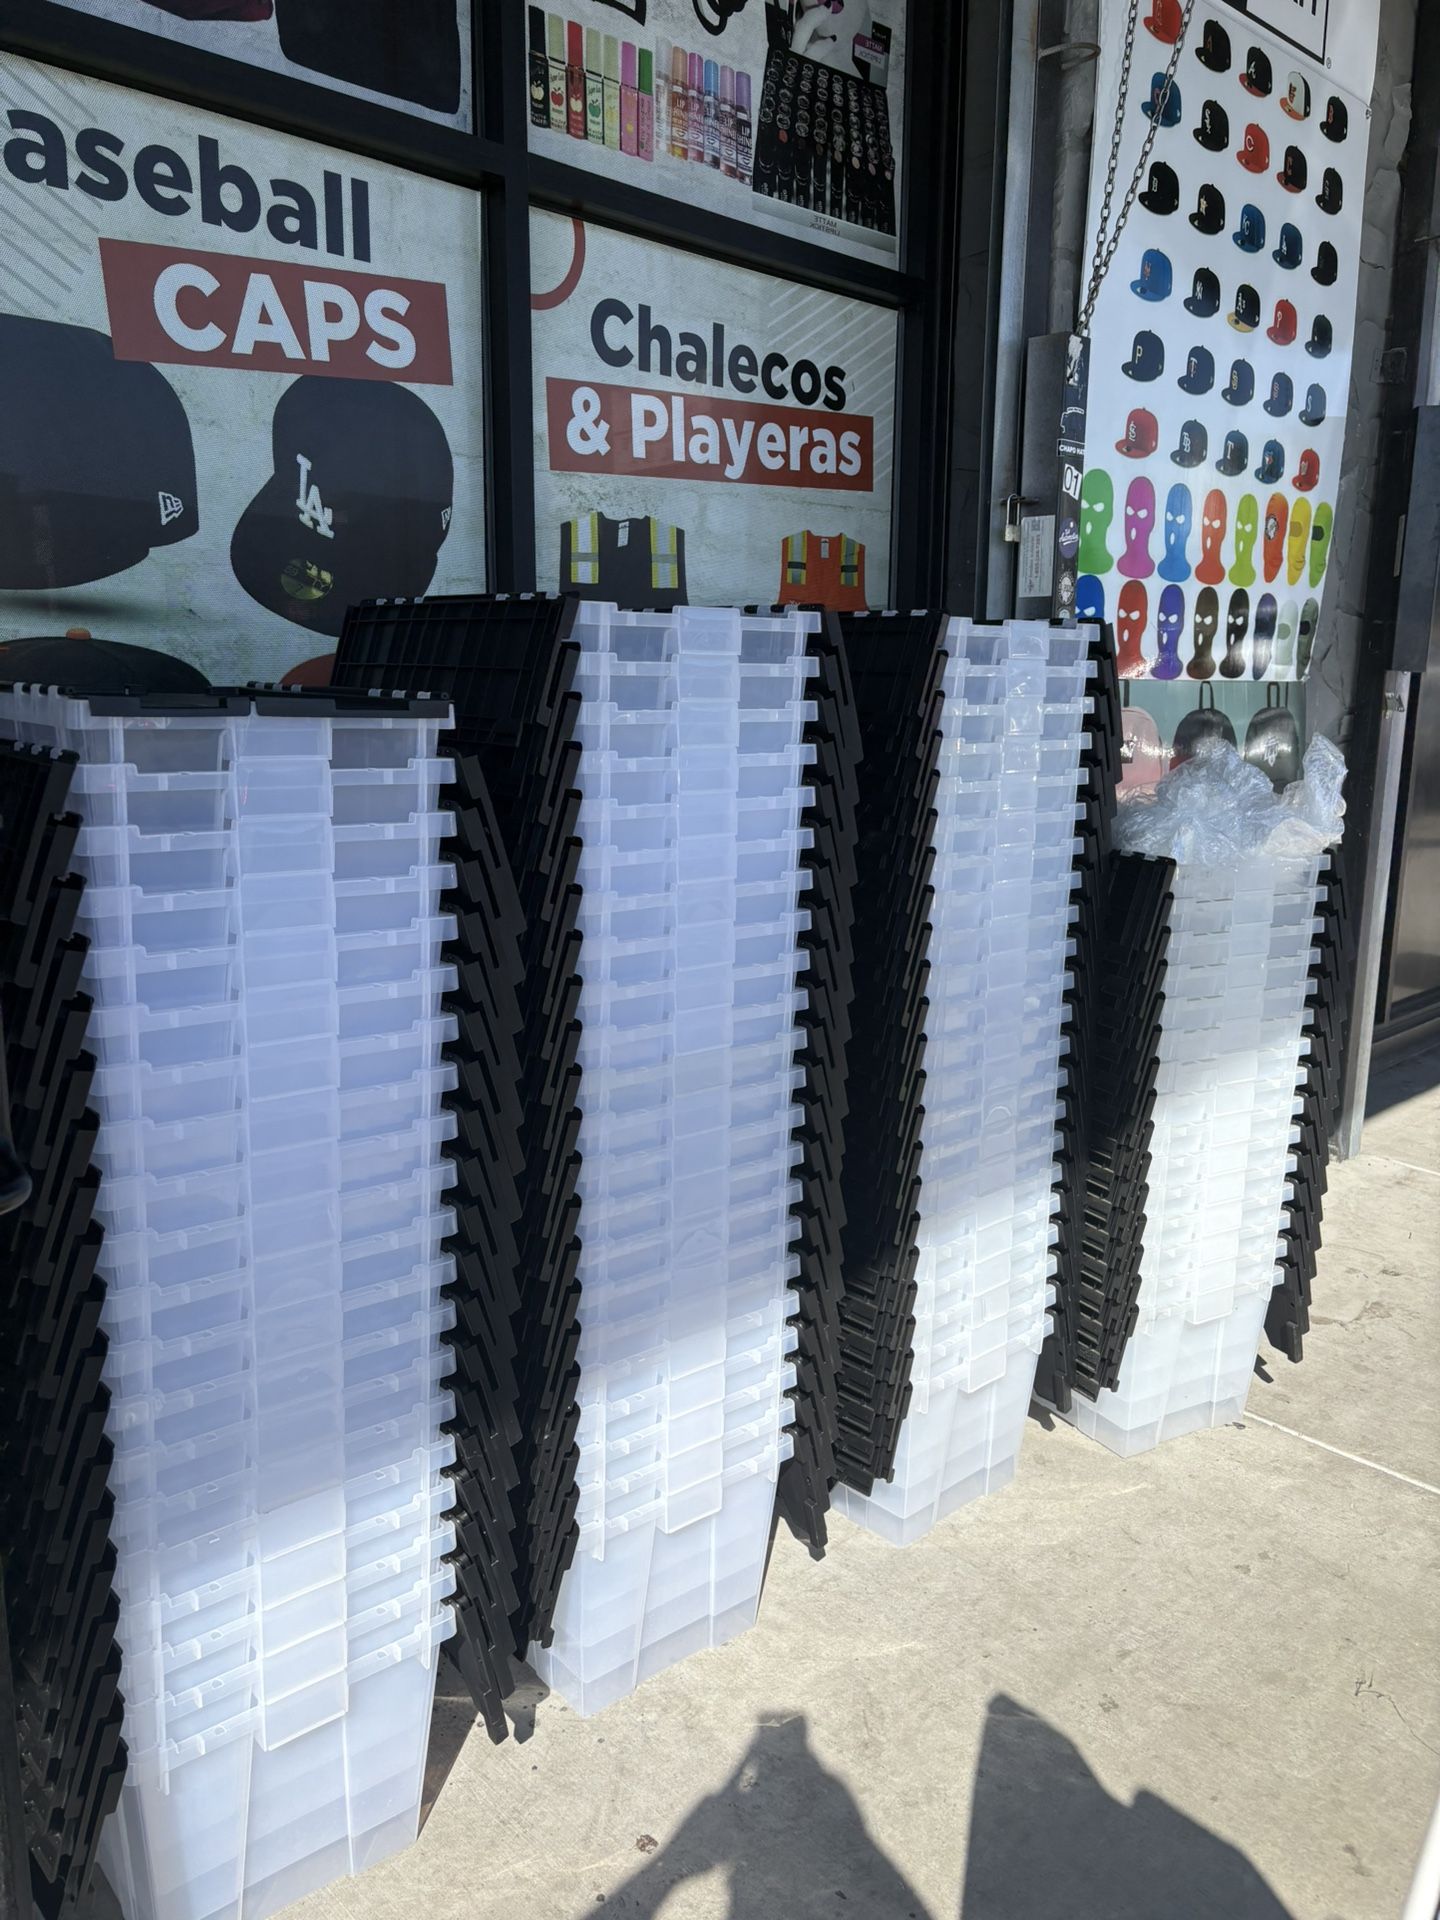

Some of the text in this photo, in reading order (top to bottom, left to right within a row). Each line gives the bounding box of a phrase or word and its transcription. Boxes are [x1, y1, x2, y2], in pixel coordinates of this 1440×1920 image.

[3, 109, 371, 263] aseball
[153, 263, 416, 369] CAPS
[590, 298, 847, 411] Chalecos
[566, 386, 862, 480] & Playeras
[1063, 466, 1080, 497] 01
[296, 453, 335, 538] LA
